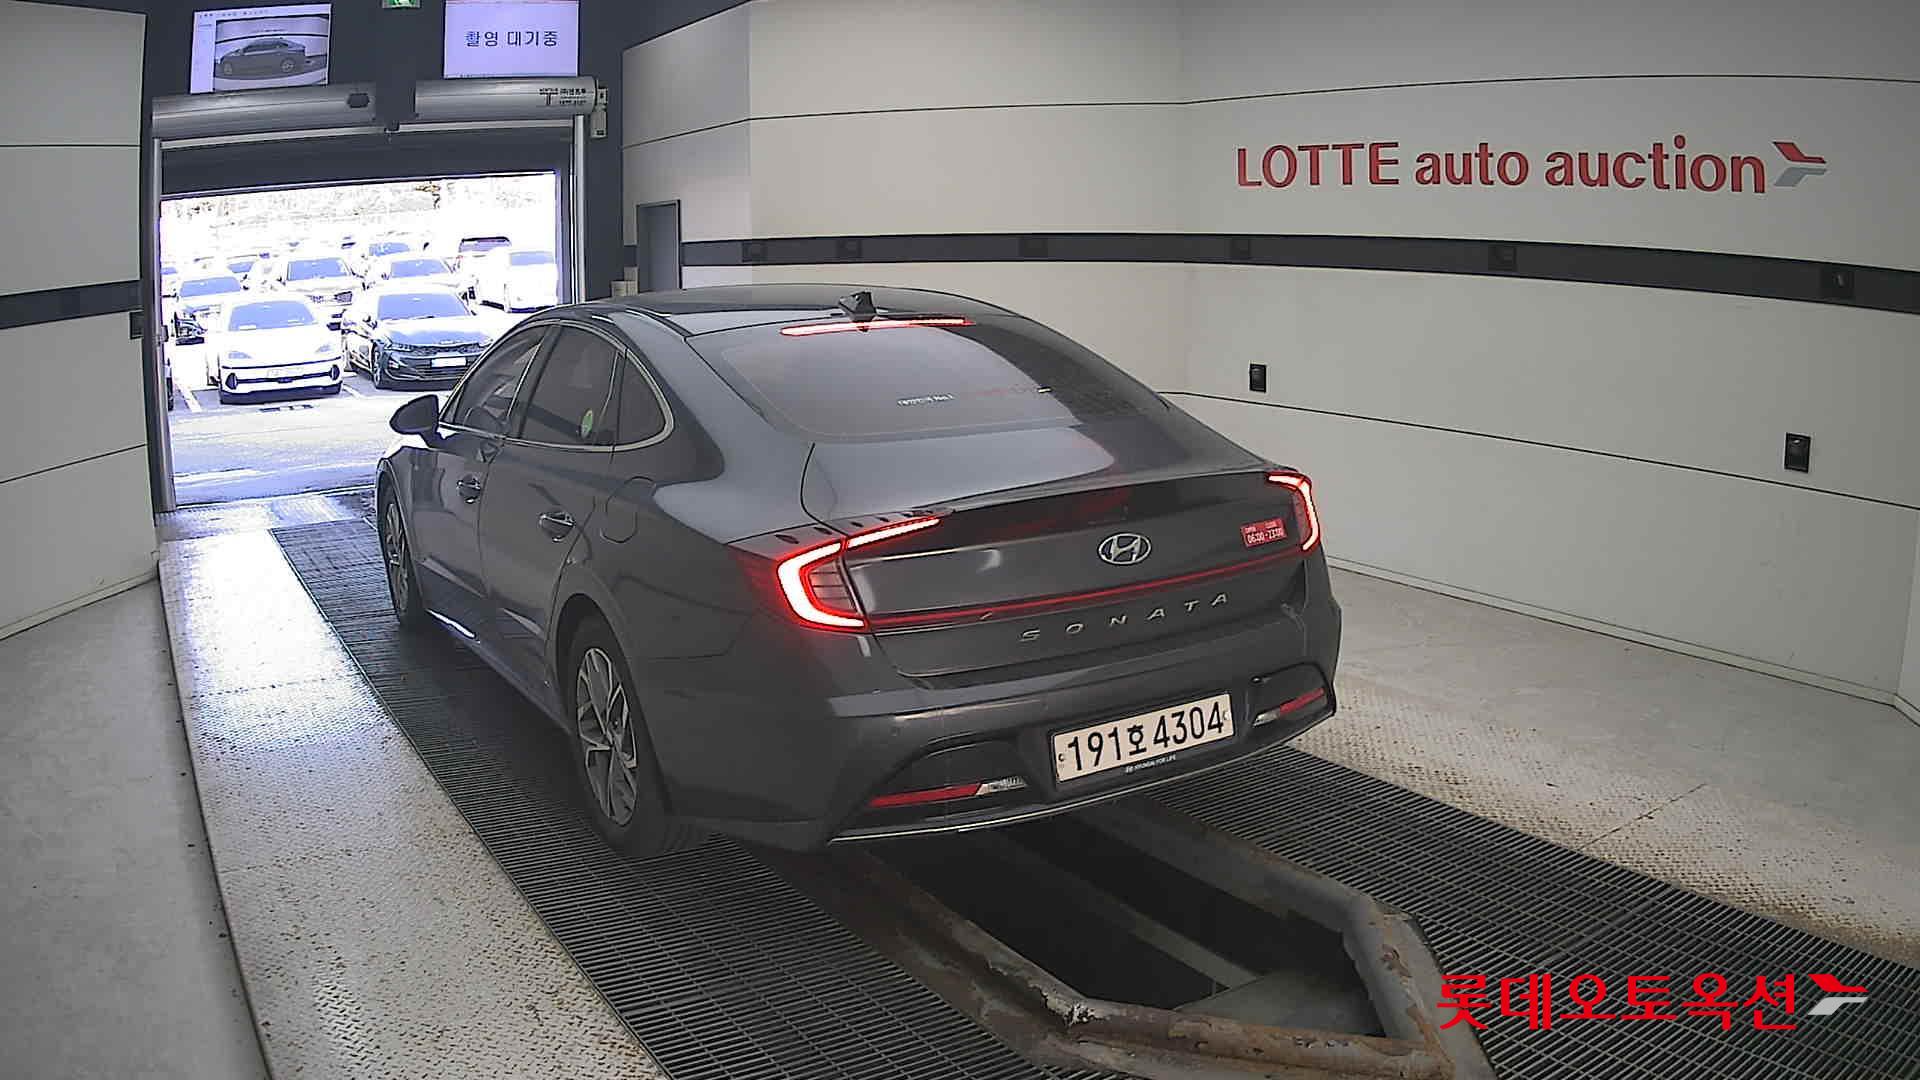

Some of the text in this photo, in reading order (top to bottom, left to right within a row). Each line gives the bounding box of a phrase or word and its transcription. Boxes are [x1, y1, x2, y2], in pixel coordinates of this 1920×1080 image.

[465, 31, 558, 47] 촬영 대기중
[1237, 135, 1766, 194] LOTTE auto auction
[1019, 592, 1229, 642] SONATA
[1067, 701, 1225, 771] 191호 4304
